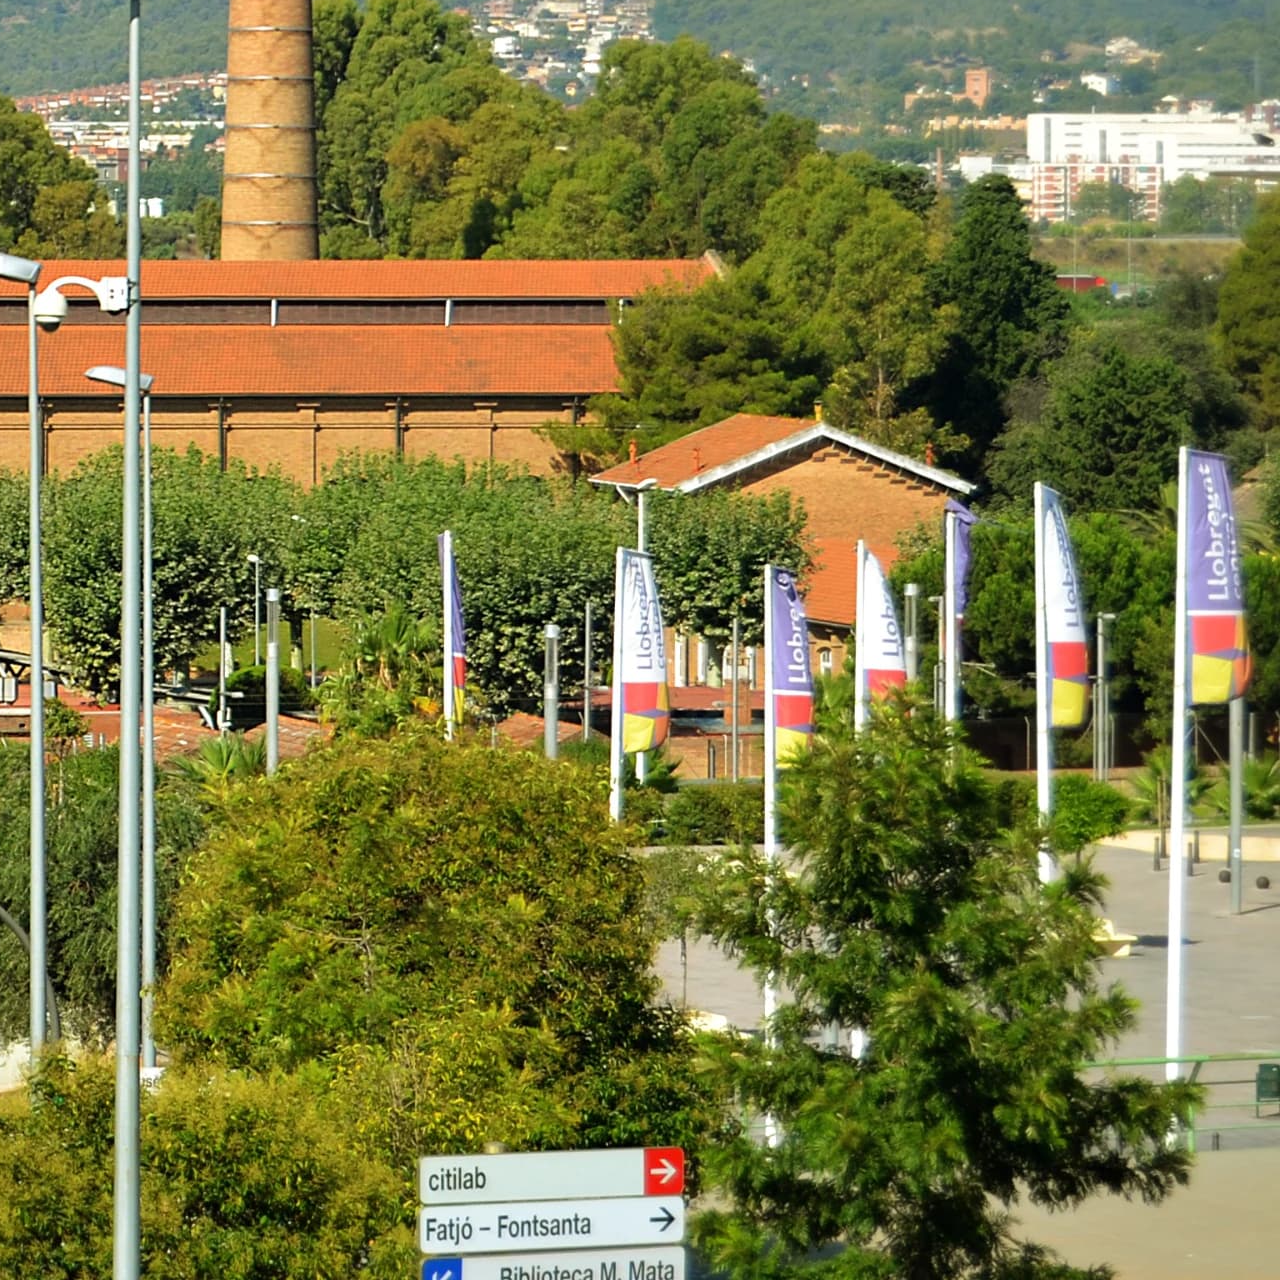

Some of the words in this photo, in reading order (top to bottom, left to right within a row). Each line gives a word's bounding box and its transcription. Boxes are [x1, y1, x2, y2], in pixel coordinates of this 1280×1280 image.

[428, 1166, 487, 1192] citilab
[425, 1216, 473, 1246] Fatjó
[497, 1213, 592, 1239] Fontsanta
[628, 1259, 675, 1280] Mata
